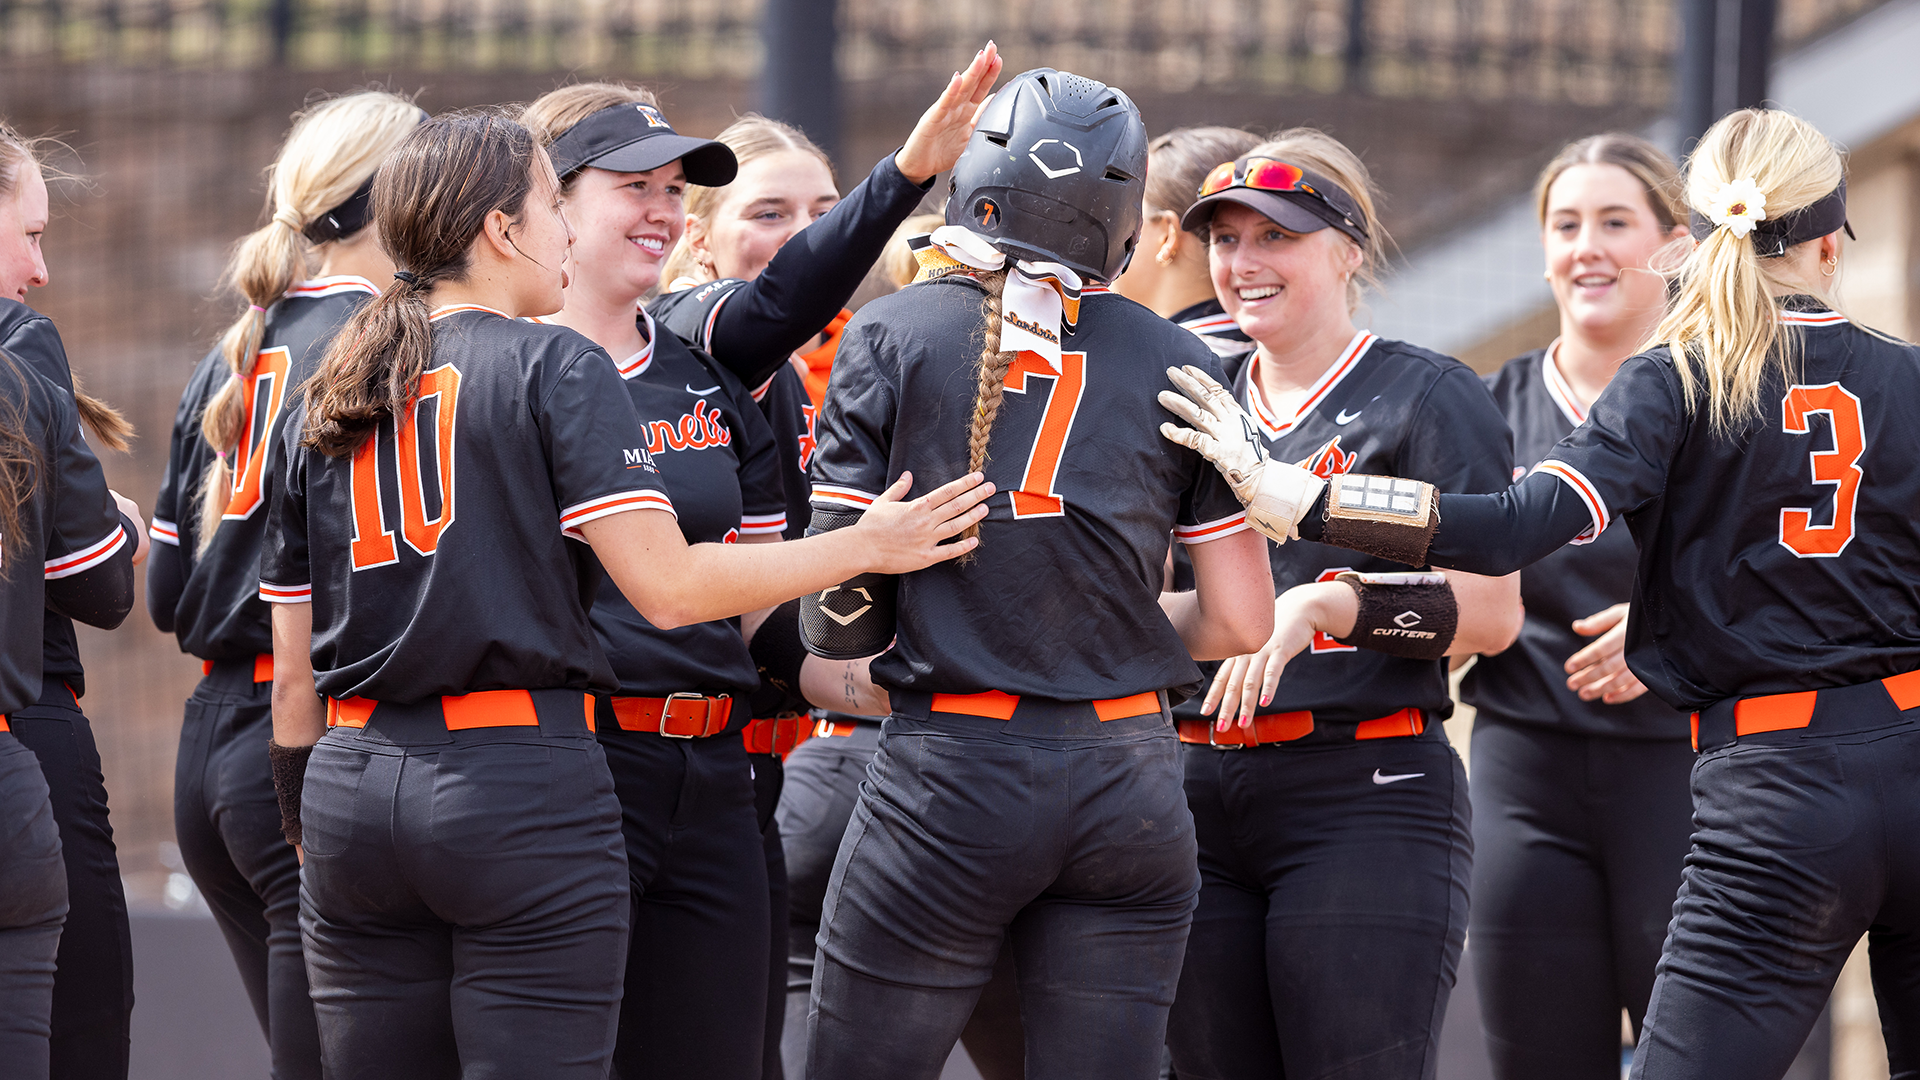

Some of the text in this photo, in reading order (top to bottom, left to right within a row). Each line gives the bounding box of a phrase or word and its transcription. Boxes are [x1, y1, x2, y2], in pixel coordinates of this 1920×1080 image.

[981, 202, 995, 226] 7
[1003, 311, 1059, 345] Landrie
[640, 399, 732, 456] nets
[1002, 350, 1088, 520] 7
[350, 361, 463, 572] 10
[1778, 381, 1867, 559] 3
[1372, 627, 1438, 640] CUTTERS
